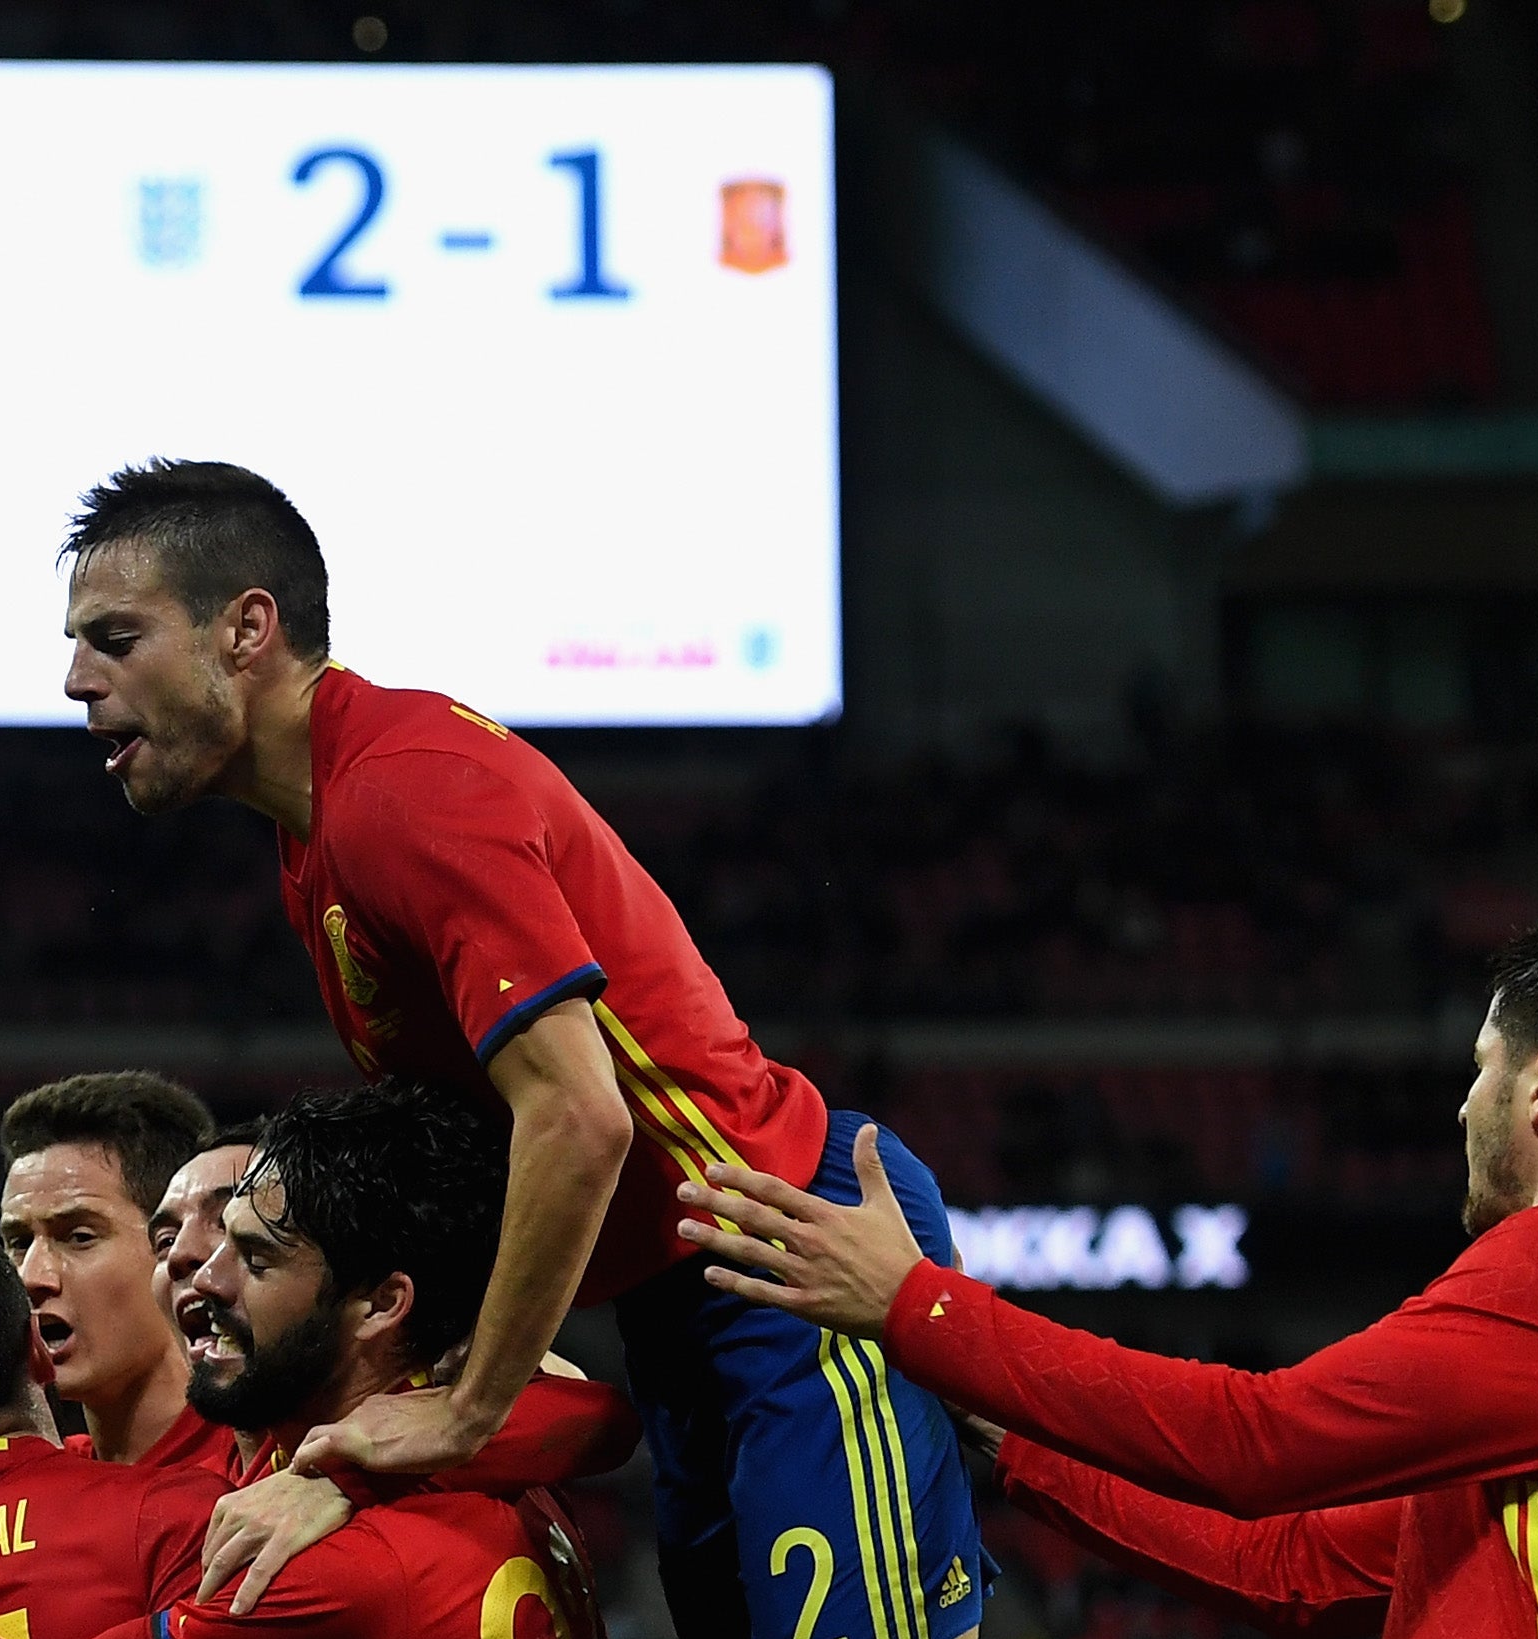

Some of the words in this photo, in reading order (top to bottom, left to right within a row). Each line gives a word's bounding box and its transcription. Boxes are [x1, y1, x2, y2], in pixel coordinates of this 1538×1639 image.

[295, 149, 387, 297] 2
[549, 153, 629, 299] 1
[1174, 1203, 1251, 1290] X
